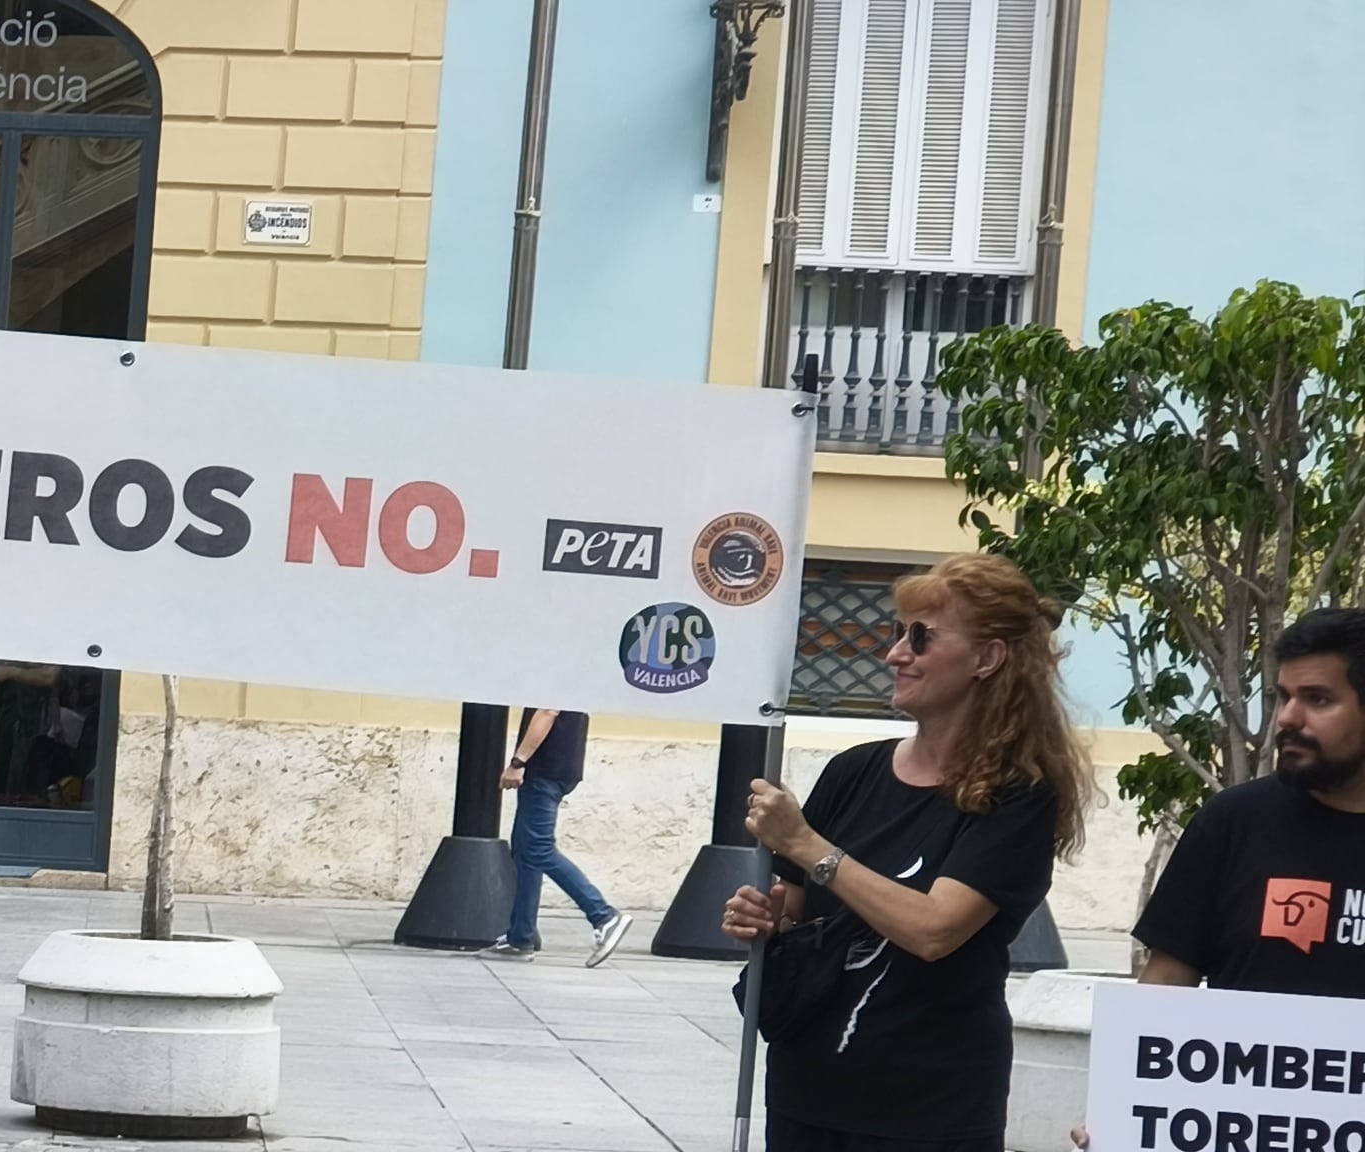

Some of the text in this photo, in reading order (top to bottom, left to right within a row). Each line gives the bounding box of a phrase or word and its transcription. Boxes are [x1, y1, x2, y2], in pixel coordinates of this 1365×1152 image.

[268, 217, 307, 228] INCENDIOS
[285, 472, 499, 578] NO.
[633, 614, 704, 666] YCS
[633, 667, 701, 688] VALENCIA
[1343, 888, 1365, 918] N
